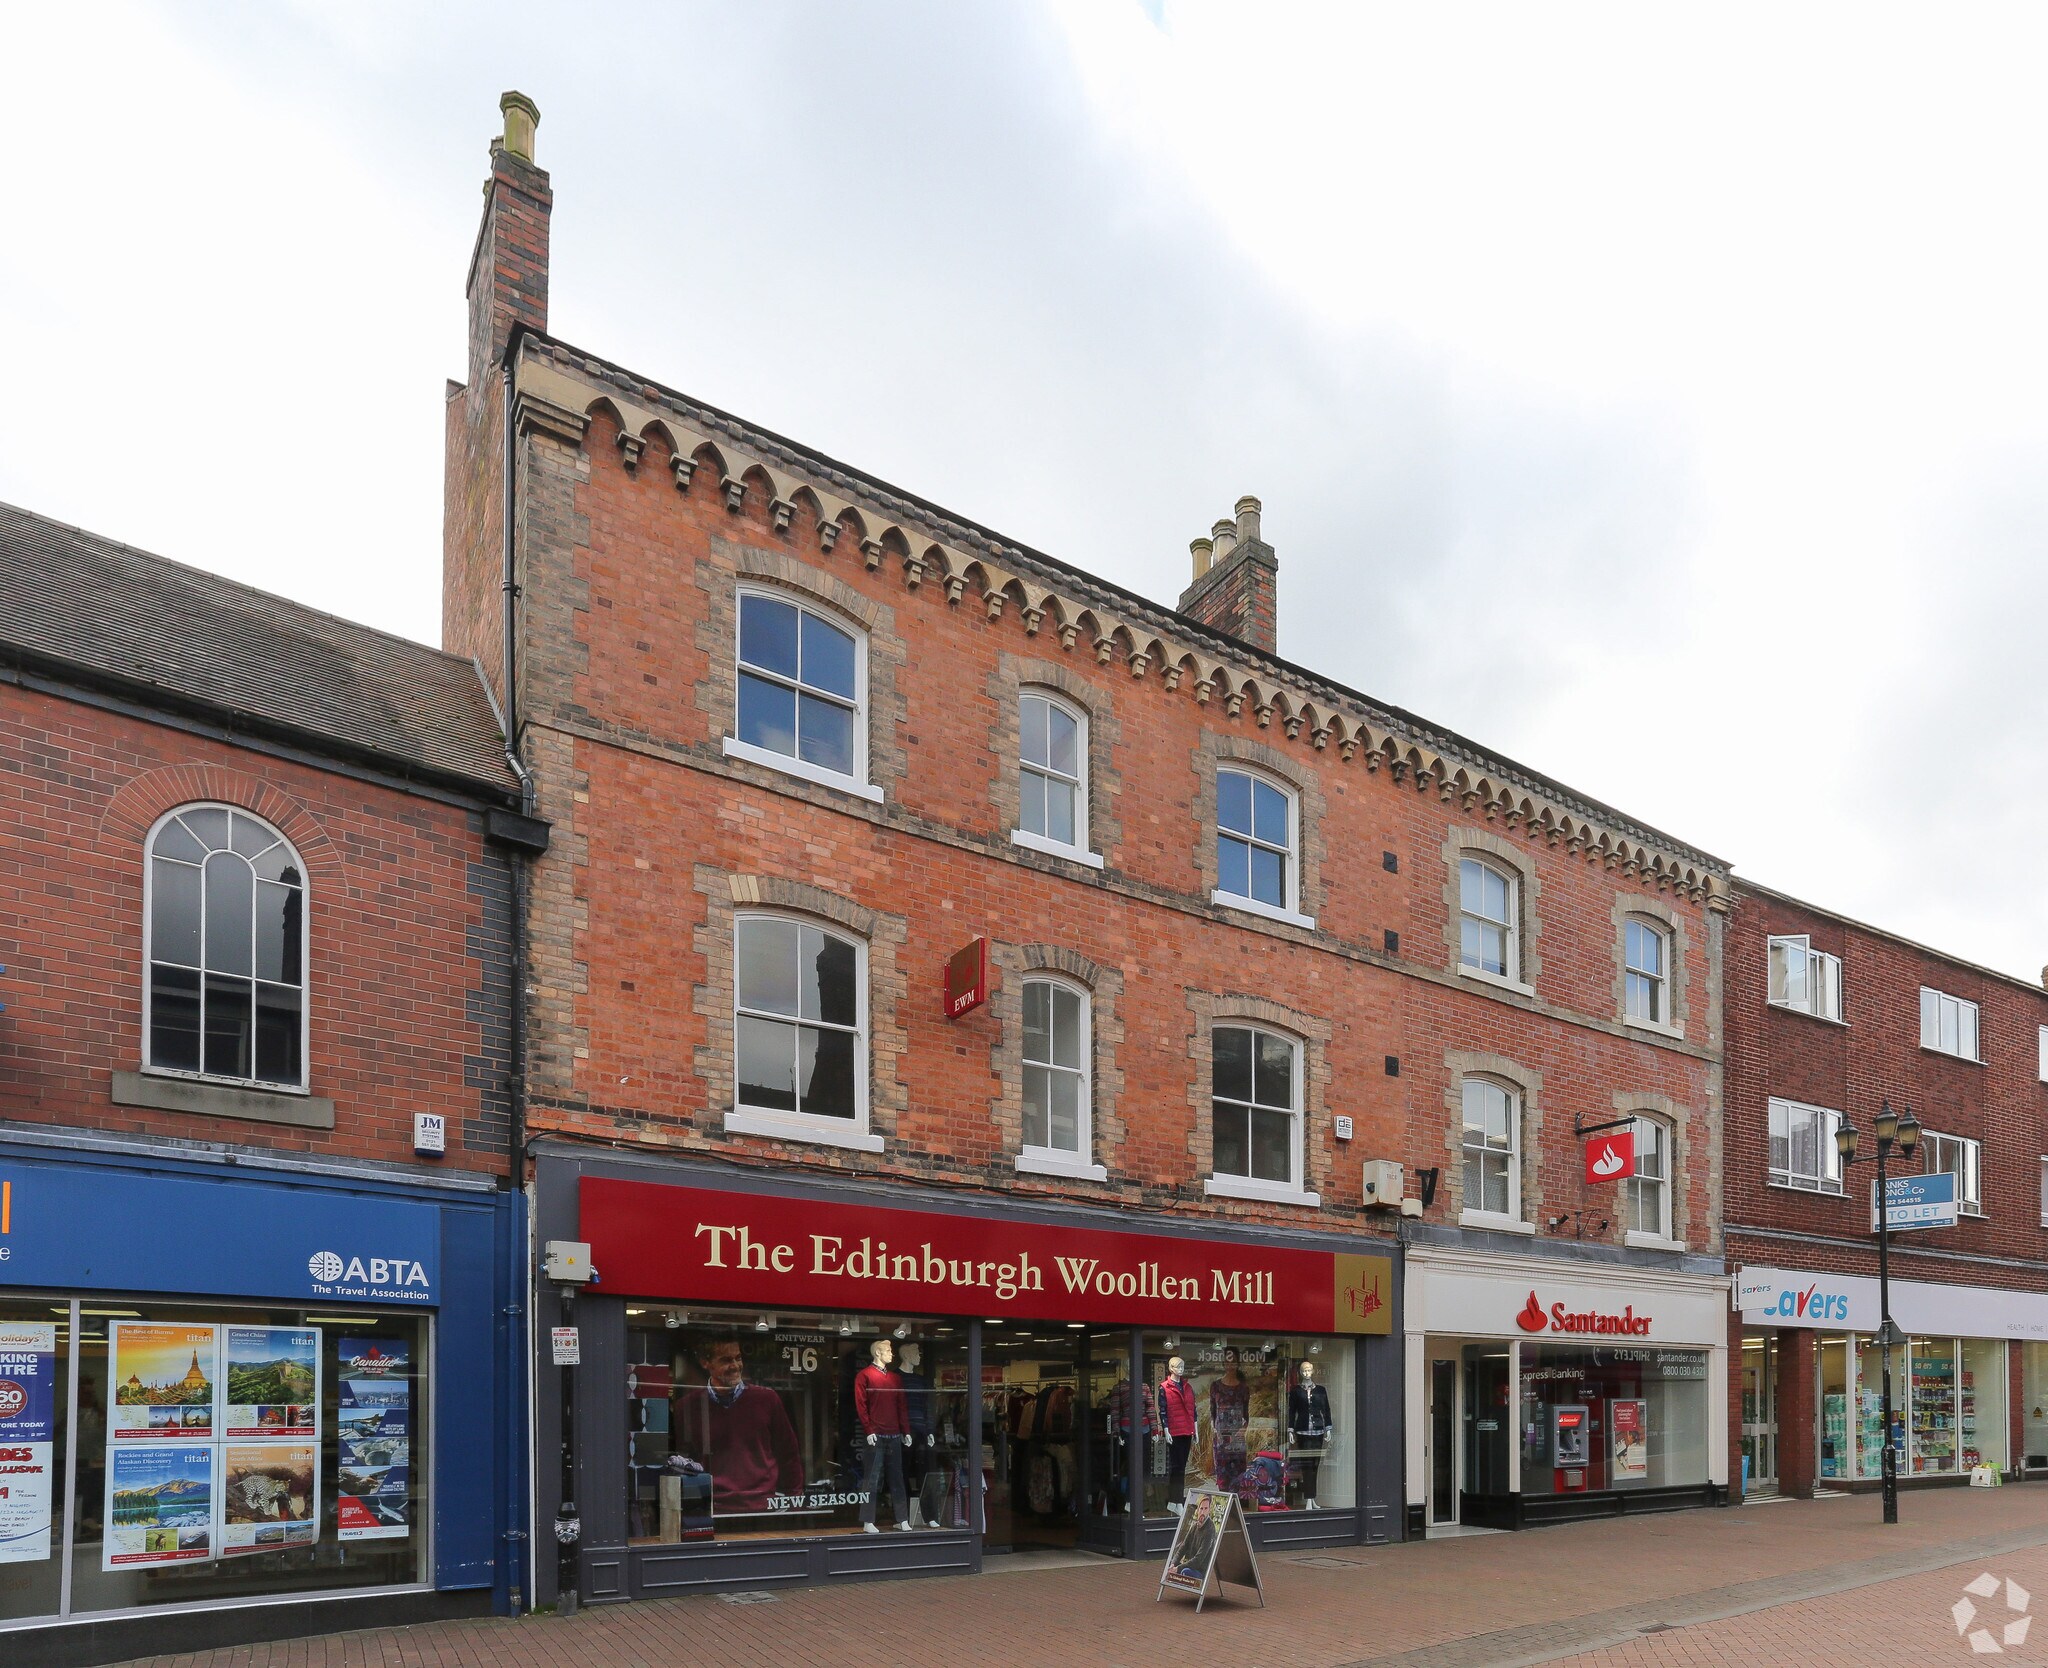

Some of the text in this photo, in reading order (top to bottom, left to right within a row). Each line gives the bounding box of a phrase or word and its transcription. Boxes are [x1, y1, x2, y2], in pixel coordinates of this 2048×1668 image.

[954, 989, 975, 1012] EWM
[421, 1117, 441, 1129] JM
[1876, 1180, 1908, 1189] ANKS
[1888, 1207, 1939, 1220] TO LET
[695, 1222, 1274, 1304] The Edinburgh Woollen Mill
[343, 1256, 430, 1287] ABTA
[312, 1284, 429, 1300] The Travel Association
[1742, 1284, 1771, 1294] savers
[1764, 1283, 1848, 1320] avers
[1551, 1302, 1652, 1335] Santander
[186, 1334, 212, 1342] titan
[775, 1334, 825, 1343] KNITWEAR
[782, 1347, 818, 1372] £16
[1520, 1368, 1585, 1382] Express Banking
[1663, 1366, 1678, 1376] 0800
[1680, 1366, 1691, 1376] 030
[184, 1454, 209, 1463] titan
[767, 1492, 870, 1509] NEW SEASON
